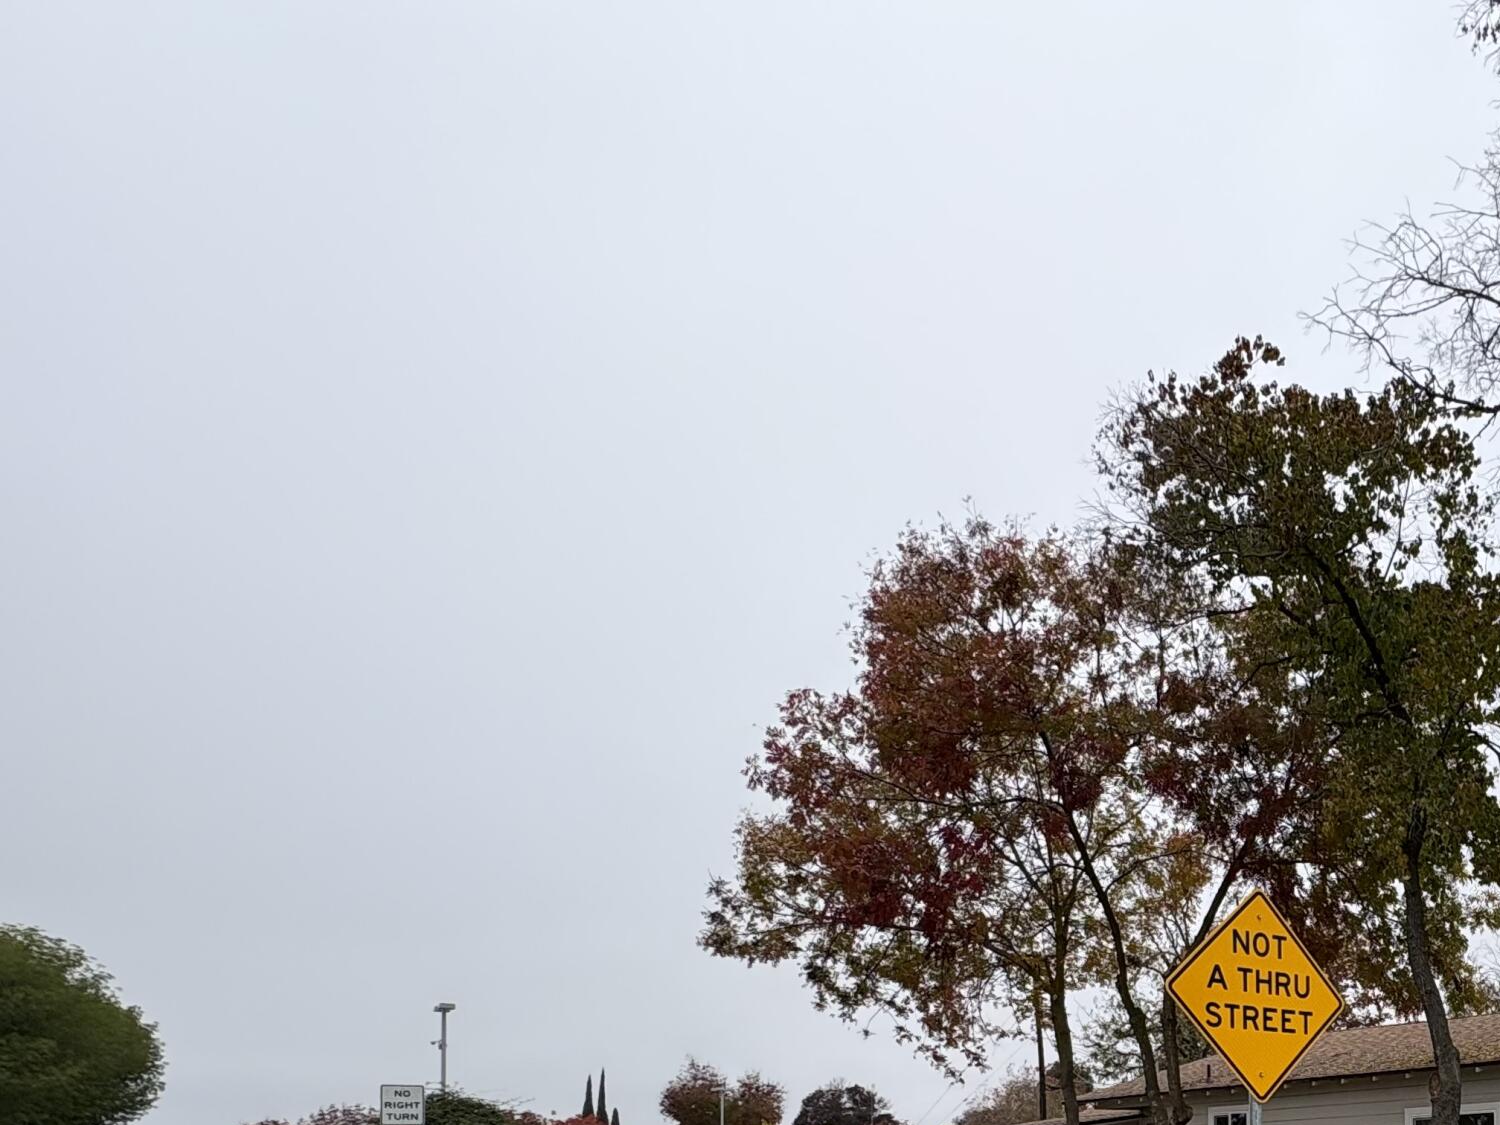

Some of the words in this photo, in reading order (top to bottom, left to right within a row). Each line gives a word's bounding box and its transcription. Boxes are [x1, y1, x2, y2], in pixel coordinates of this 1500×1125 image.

[1232, 928, 1287, 960] NOT
[1207, 964, 1228, 990] A
[1237, 967, 1311, 999] THRU
[1205, 1001, 1313, 1035] STREET
[384, 1101, 420, 1109] RIGHT
